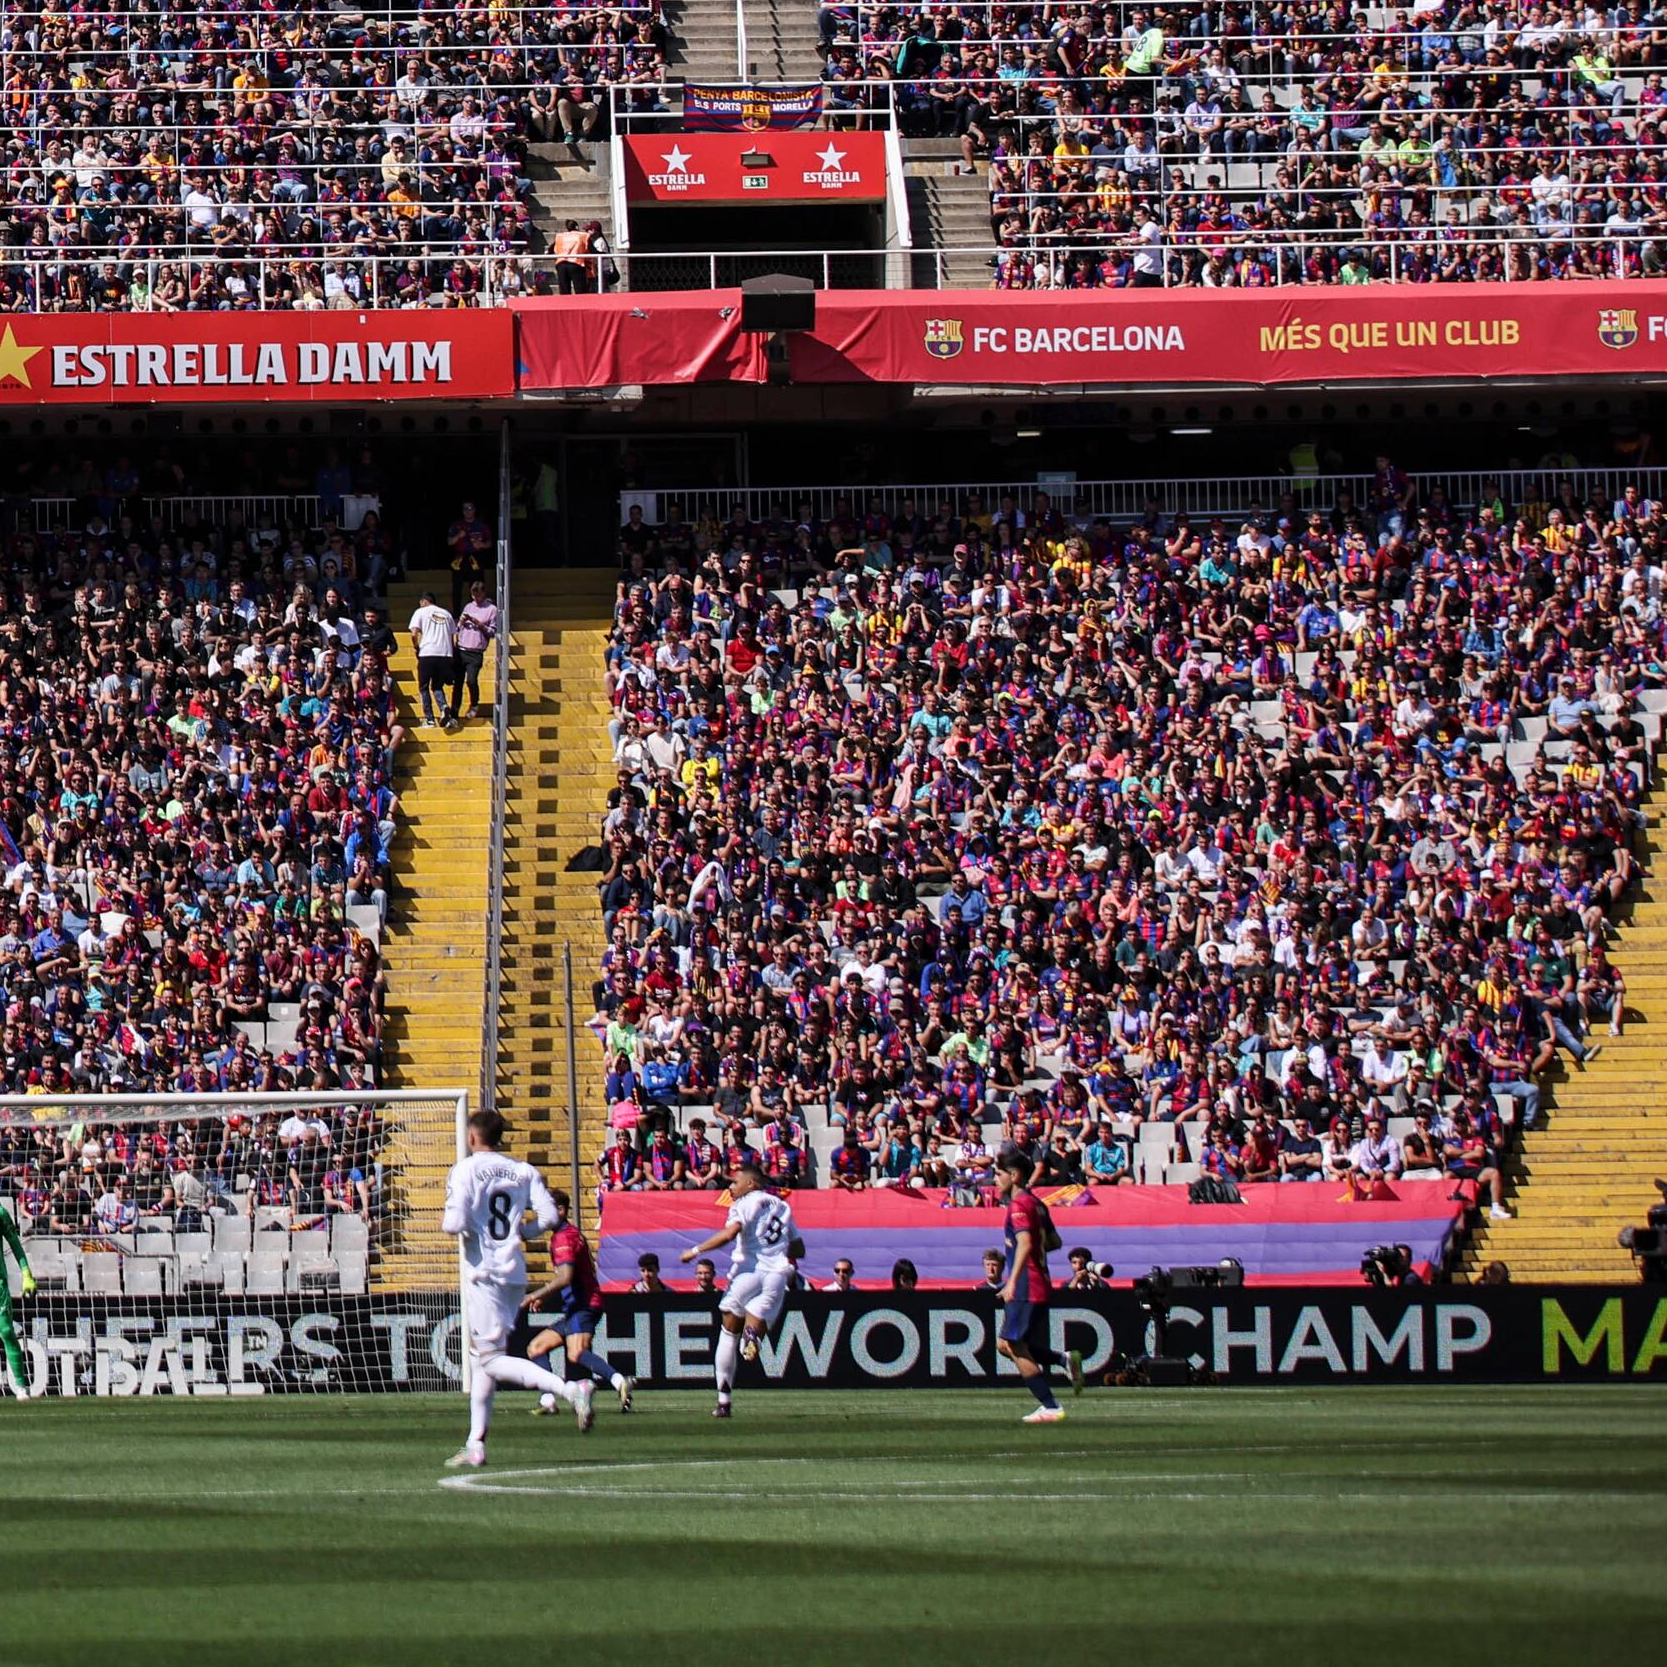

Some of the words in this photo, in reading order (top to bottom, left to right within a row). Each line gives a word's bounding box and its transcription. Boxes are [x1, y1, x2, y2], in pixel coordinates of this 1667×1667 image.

[694, 99, 709, 109] ELS
[713, 101, 741, 111] PORTS
[772, 101, 814, 111] MORELLA
[648, 174, 706, 185] ESTRELLA
[803, 172, 860, 183] ESTRELLA
[973, 327, 1007, 352] FC
[1014, 325, 1186, 352] BARCELONA
[1260, 318, 1321, 352] MÉS
[1328, 321, 1389, 350] QUE
[1397, 321, 1438, 347] UN
[1445, 320, 1520, 346] CLUB
[1648, 316, 1667, 341] F
[51, 342, 287, 387] ESTRELLA
[299, 341, 452, 384] DAMM
[488, 1190, 511, 1241] 8
[1145, 1302, 1491, 1374] CHAMP
